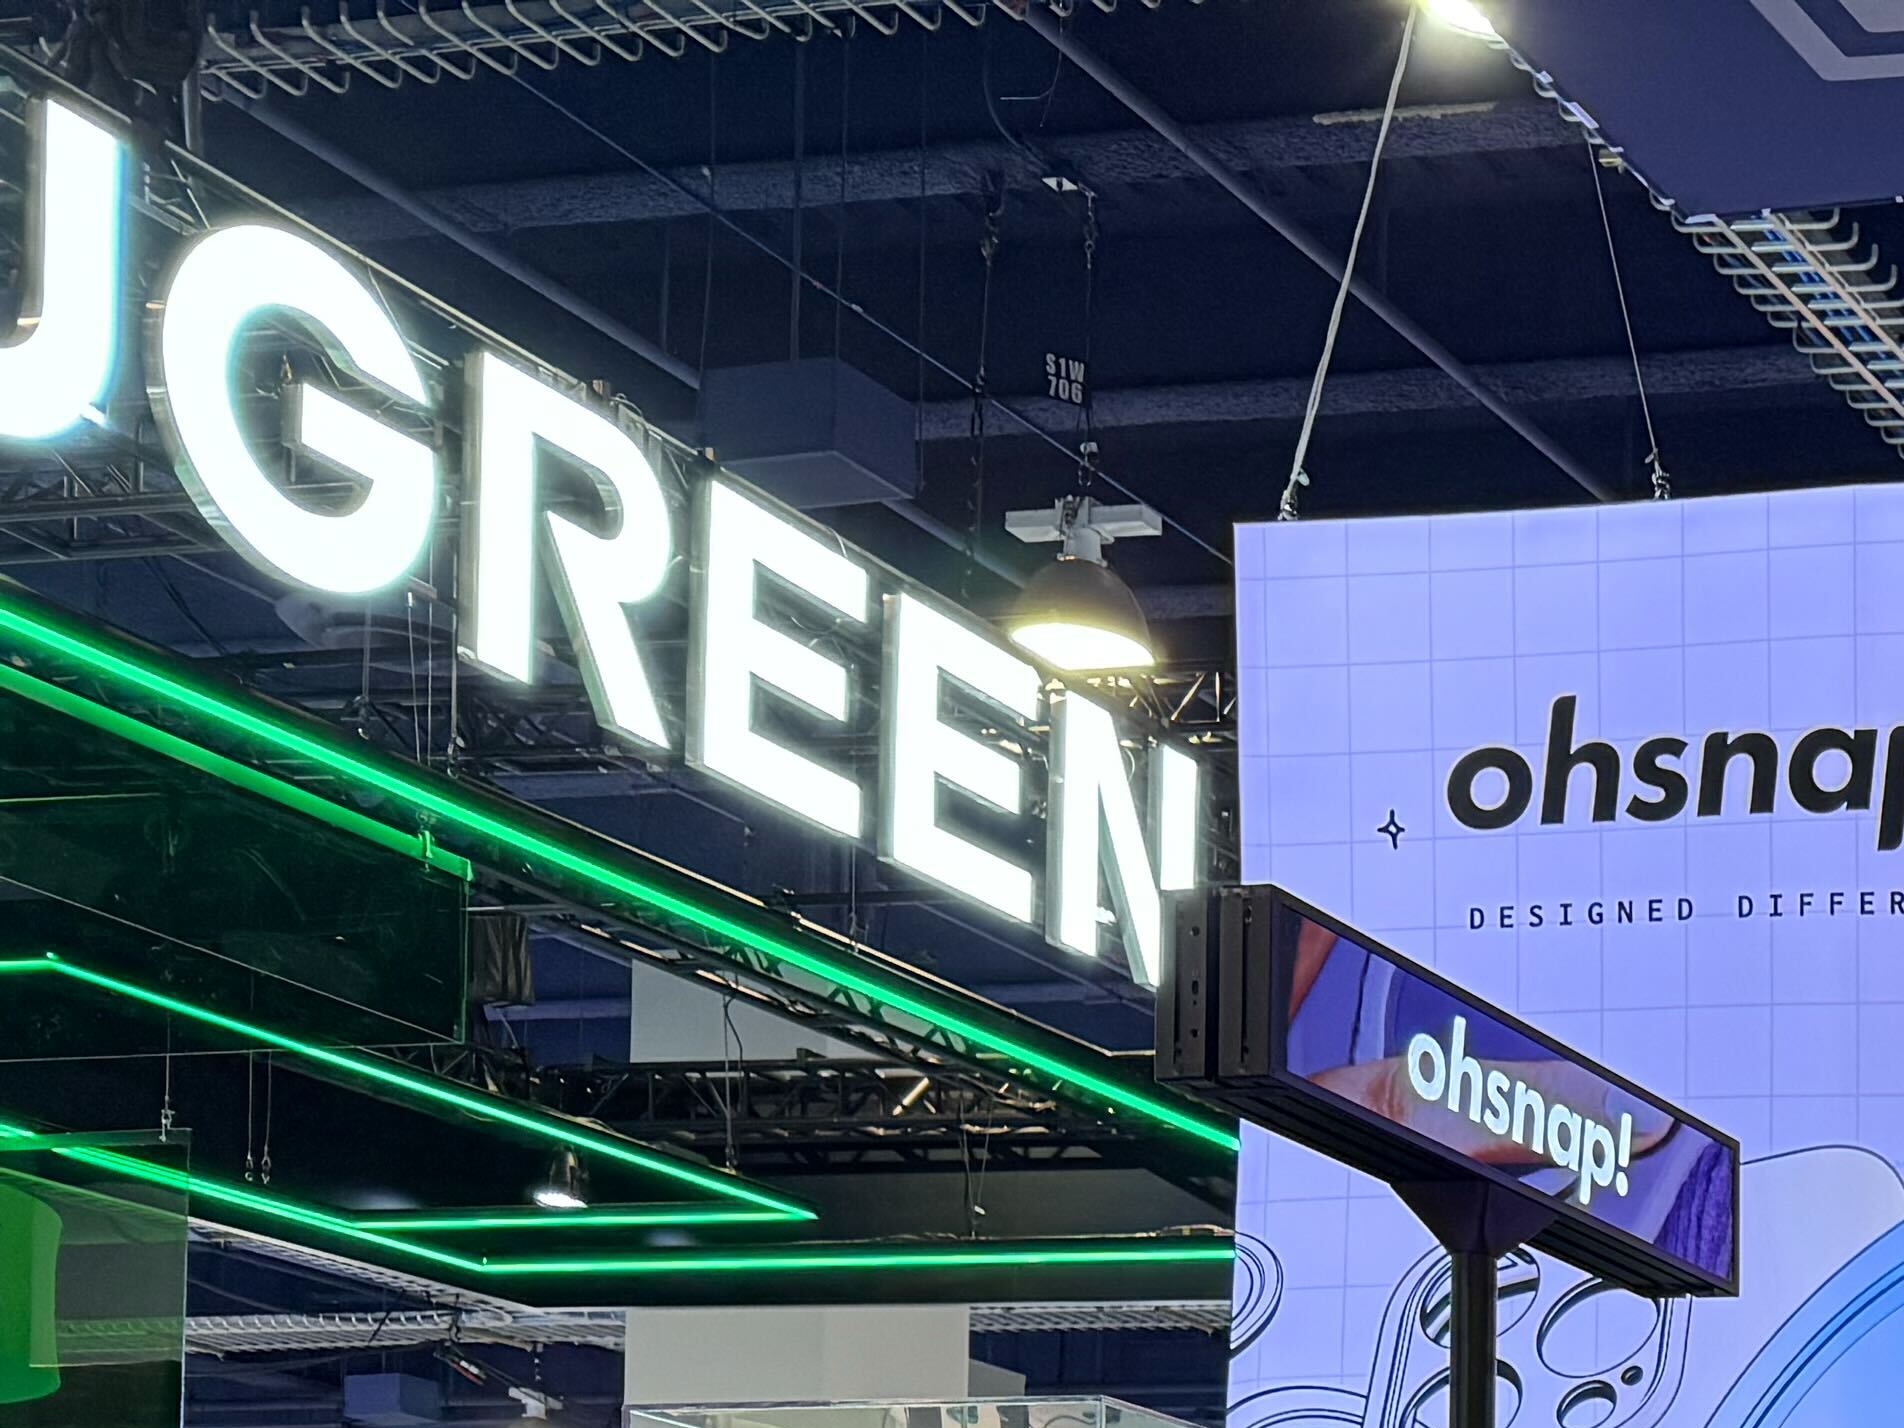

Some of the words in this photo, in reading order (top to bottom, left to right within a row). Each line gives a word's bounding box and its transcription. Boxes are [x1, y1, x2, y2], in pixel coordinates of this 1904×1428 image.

[1045, 353, 1085, 382] S1W
[1047, 375, 1083, 404] 706
[1469, 897, 1694, 930] DESIGNED
[1406, 1015, 1633, 1204] ohsnap!
